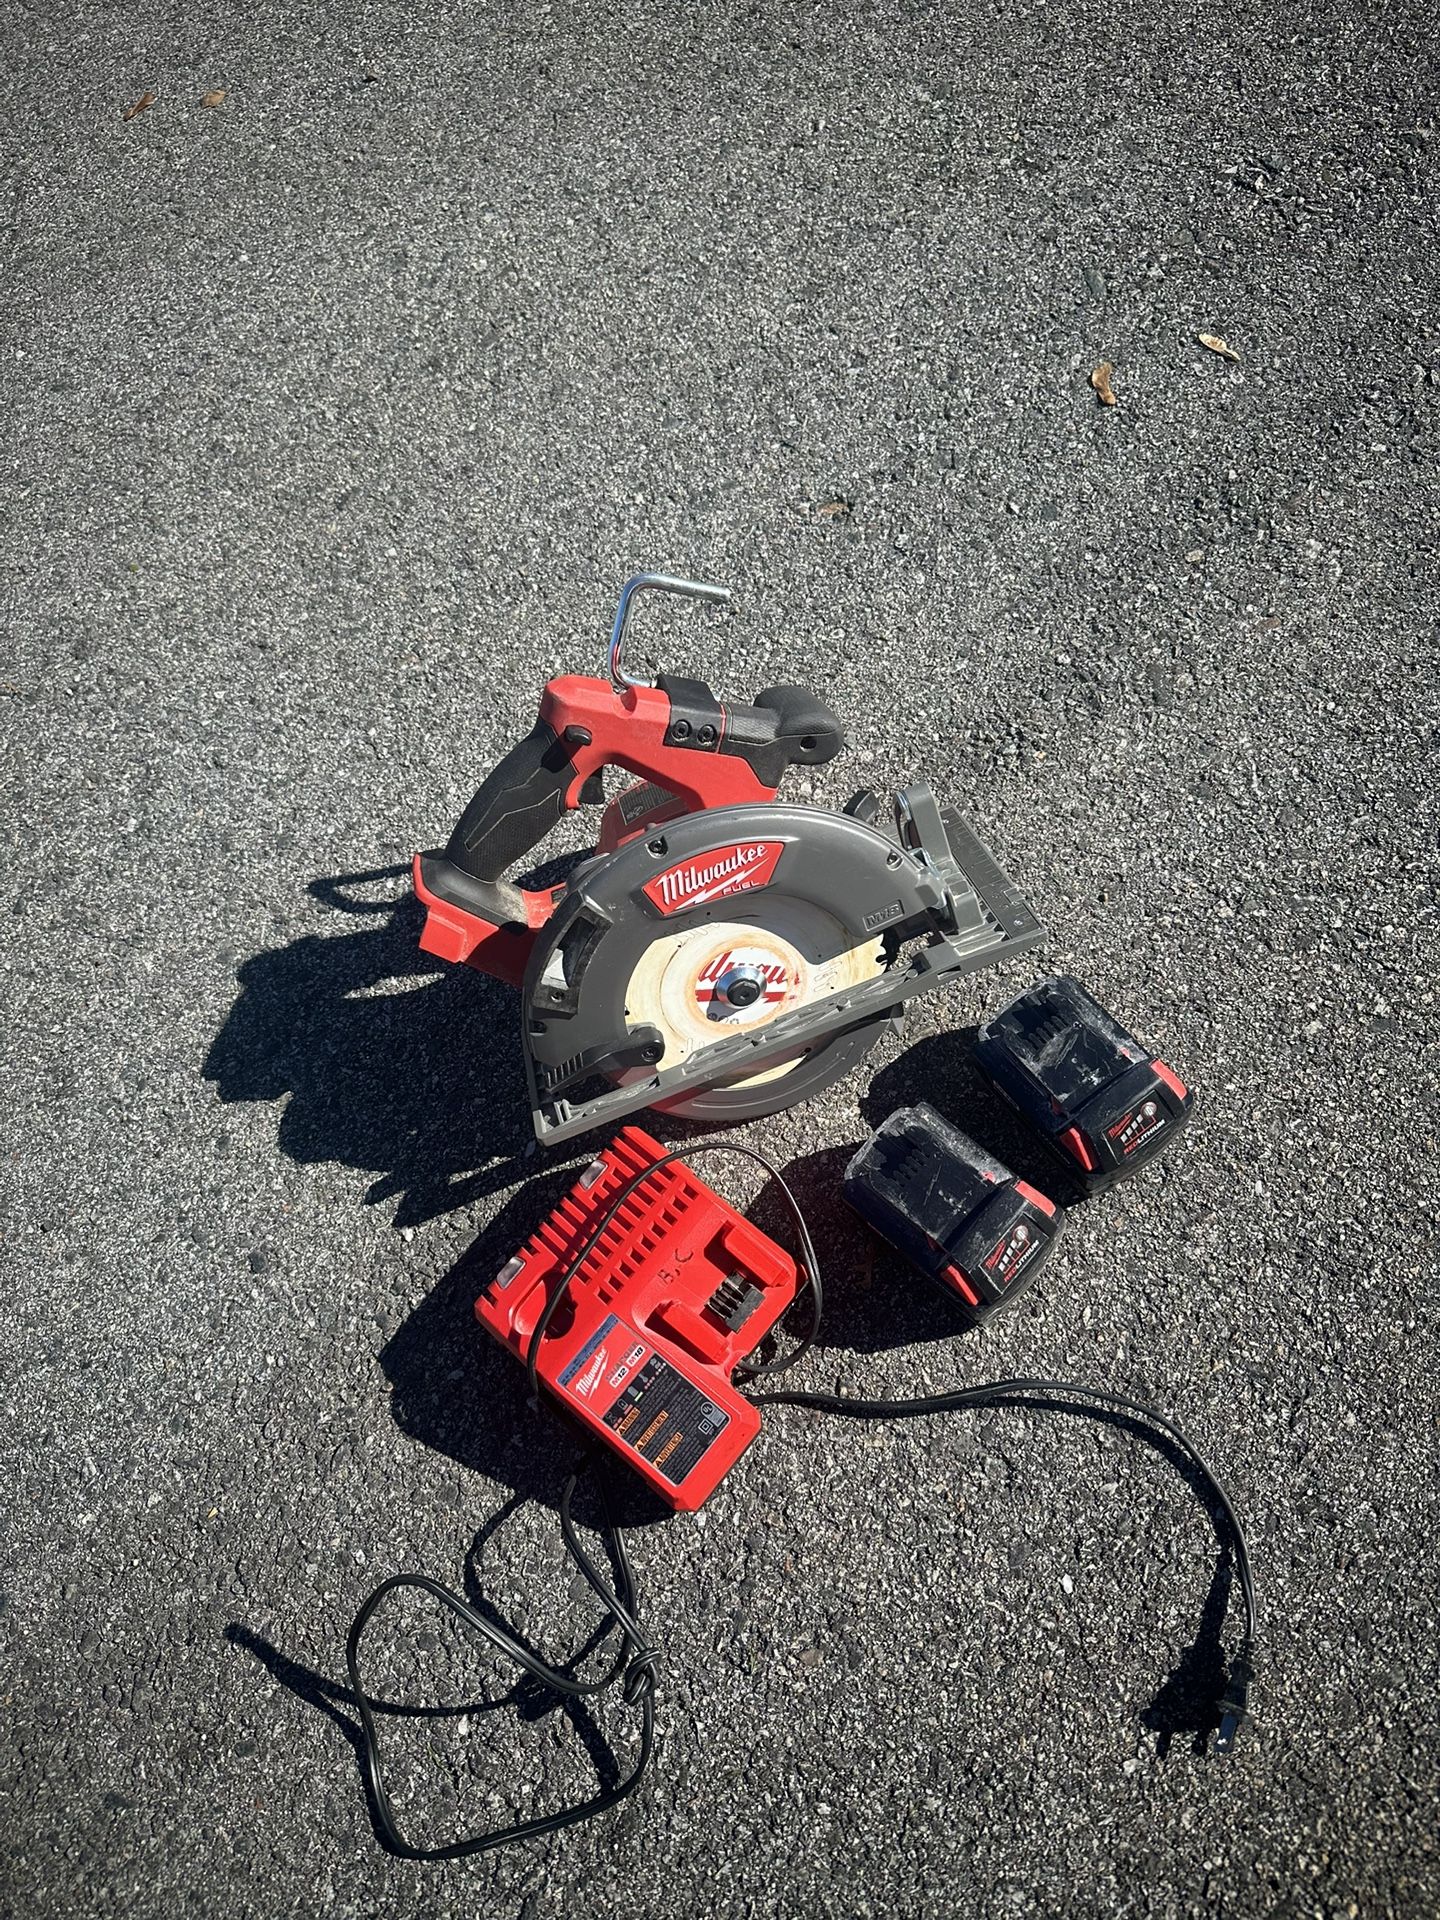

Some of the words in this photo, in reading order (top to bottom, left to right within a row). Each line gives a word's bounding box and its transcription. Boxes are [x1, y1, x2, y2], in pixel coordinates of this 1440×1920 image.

[655, 845, 769, 905] Milwaukee
[723, 880, 760, 895] FUEL
[575, 1346, 608, 1397] Milwaukee
[611, 1367, 627, 1386] M12
[627, 1346, 644, 1365] M18
